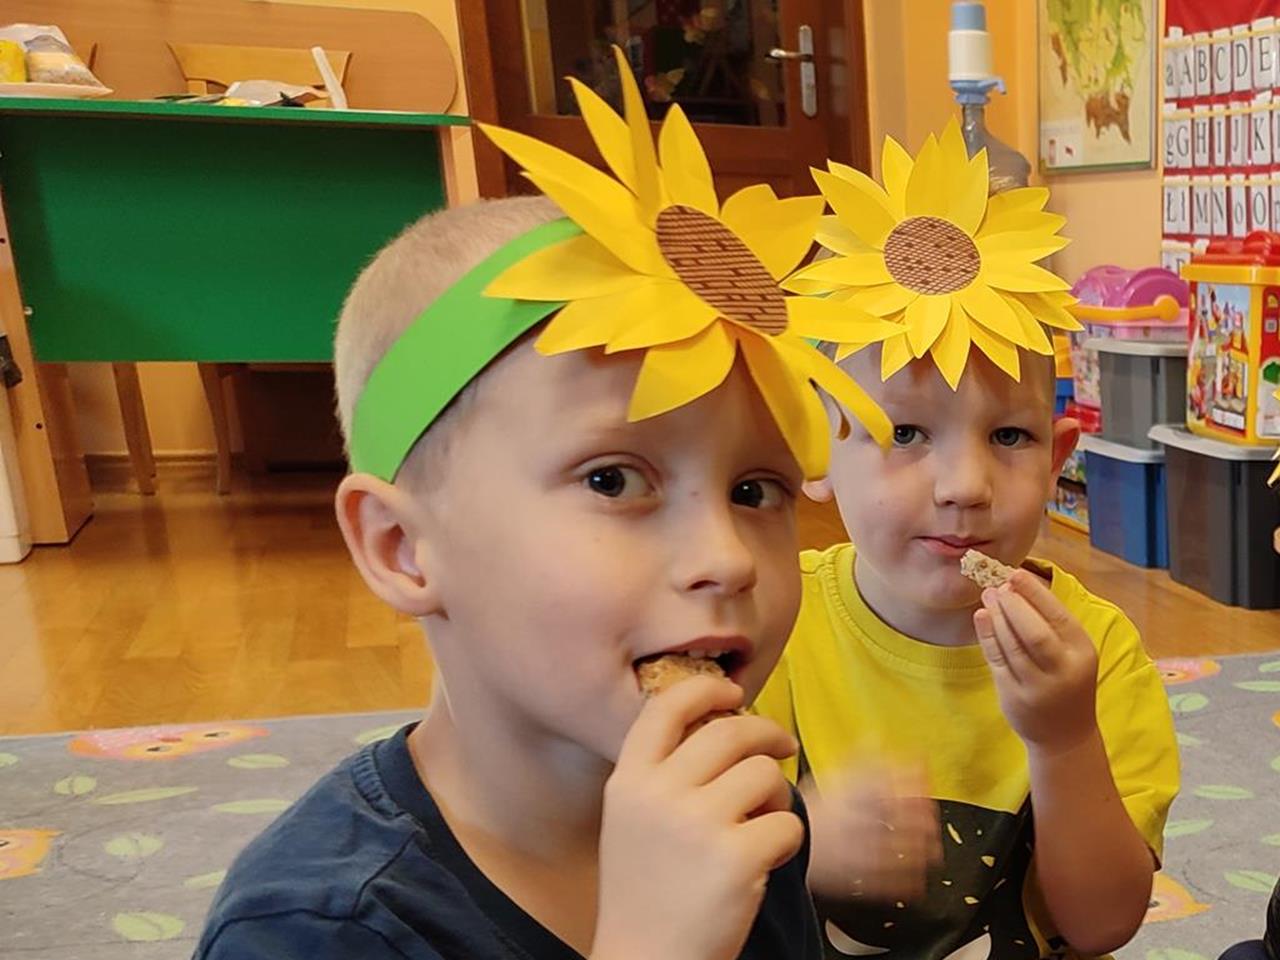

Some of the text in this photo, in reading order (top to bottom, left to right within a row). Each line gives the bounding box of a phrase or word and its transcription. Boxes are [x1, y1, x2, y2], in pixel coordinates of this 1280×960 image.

[1166, 64, 1174, 87] a
[1180, 55, 1193, 86] A
[1197, 49, 1208, 83] B
[1215, 45, 1226, 82] C
[1235, 43, 1249, 78] D
[1258, 36, 1273, 72] E
[1166, 132, 1175, 165] g
[1176, 125, 1190, 158] G
[1196, 121, 1207, 155] H
[1232, 118, 1240, 153] J
[1253, 117, 1266, 152] K
[1195, 192, 1209, 224] M
[1213, 191, 1225, 223] N
[1253, 191, 1267, 226] O
